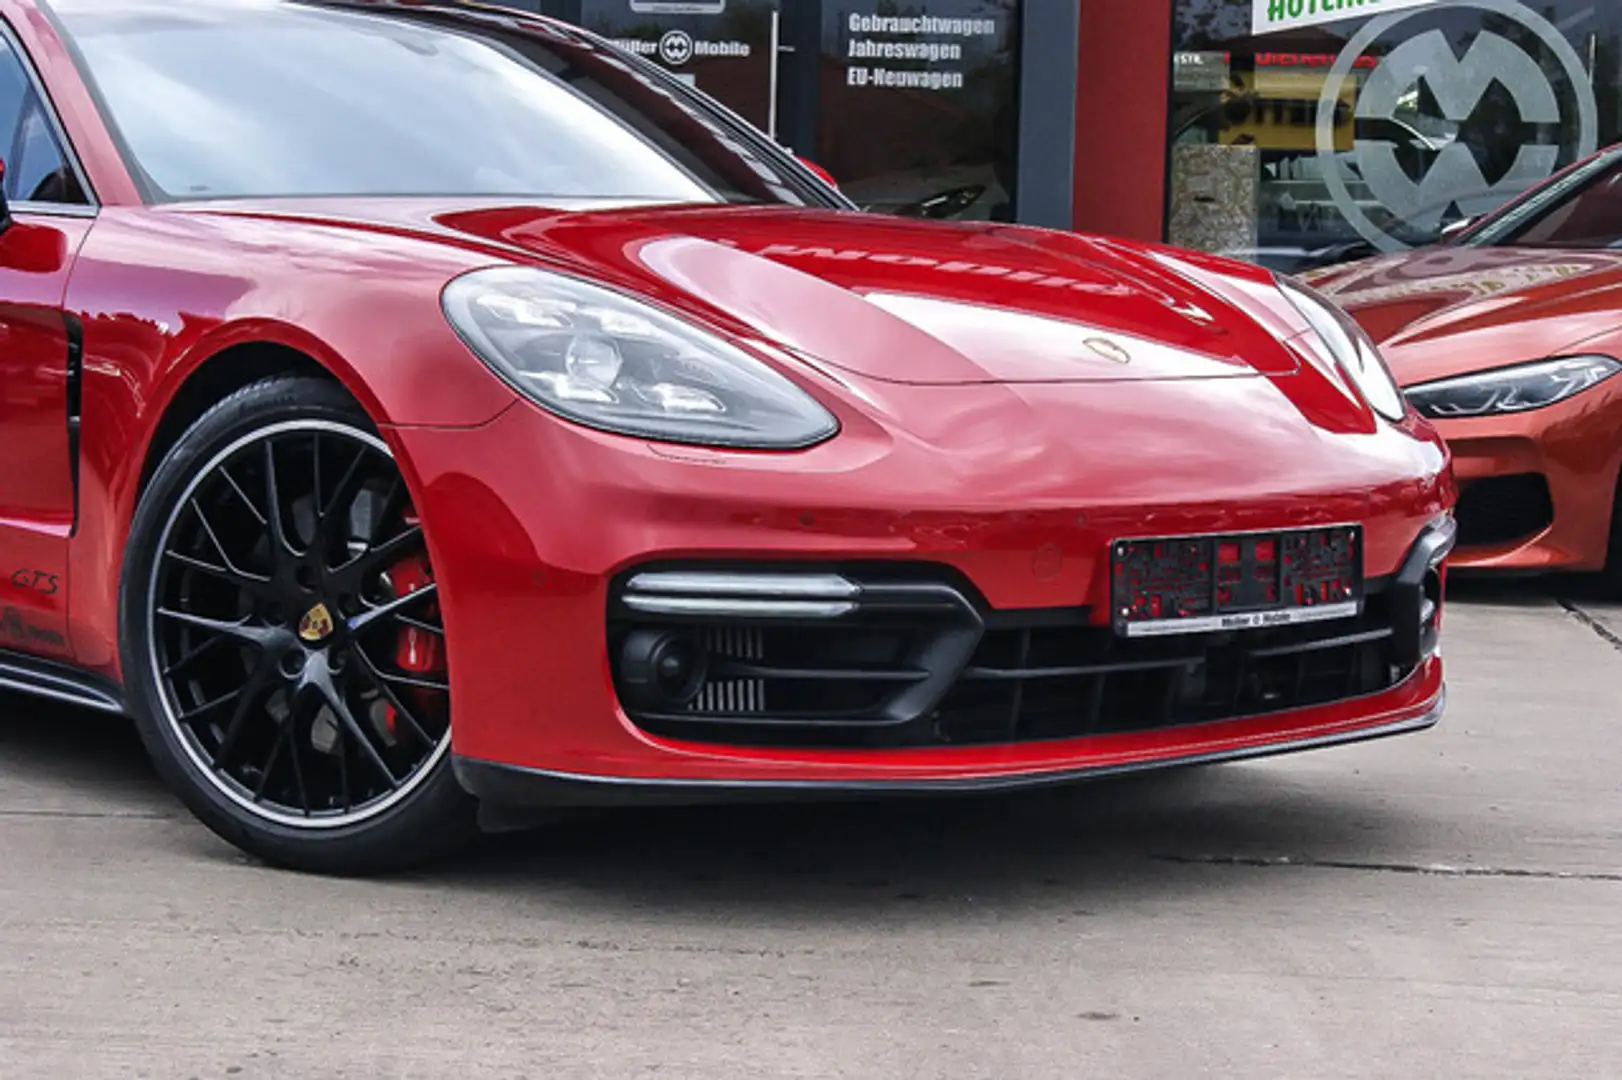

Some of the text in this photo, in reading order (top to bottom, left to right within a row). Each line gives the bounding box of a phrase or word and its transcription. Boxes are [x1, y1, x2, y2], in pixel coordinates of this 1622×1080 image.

[848, 13, 995, 36] Gebrauchtwagen
[608, 38, 750, 57] üller Mobile
[848, 38, 961, 61] Jahreswagen
[847, 67, 963, 90] EU-Neuwagen
[10, 568, 59, 595] GTS
